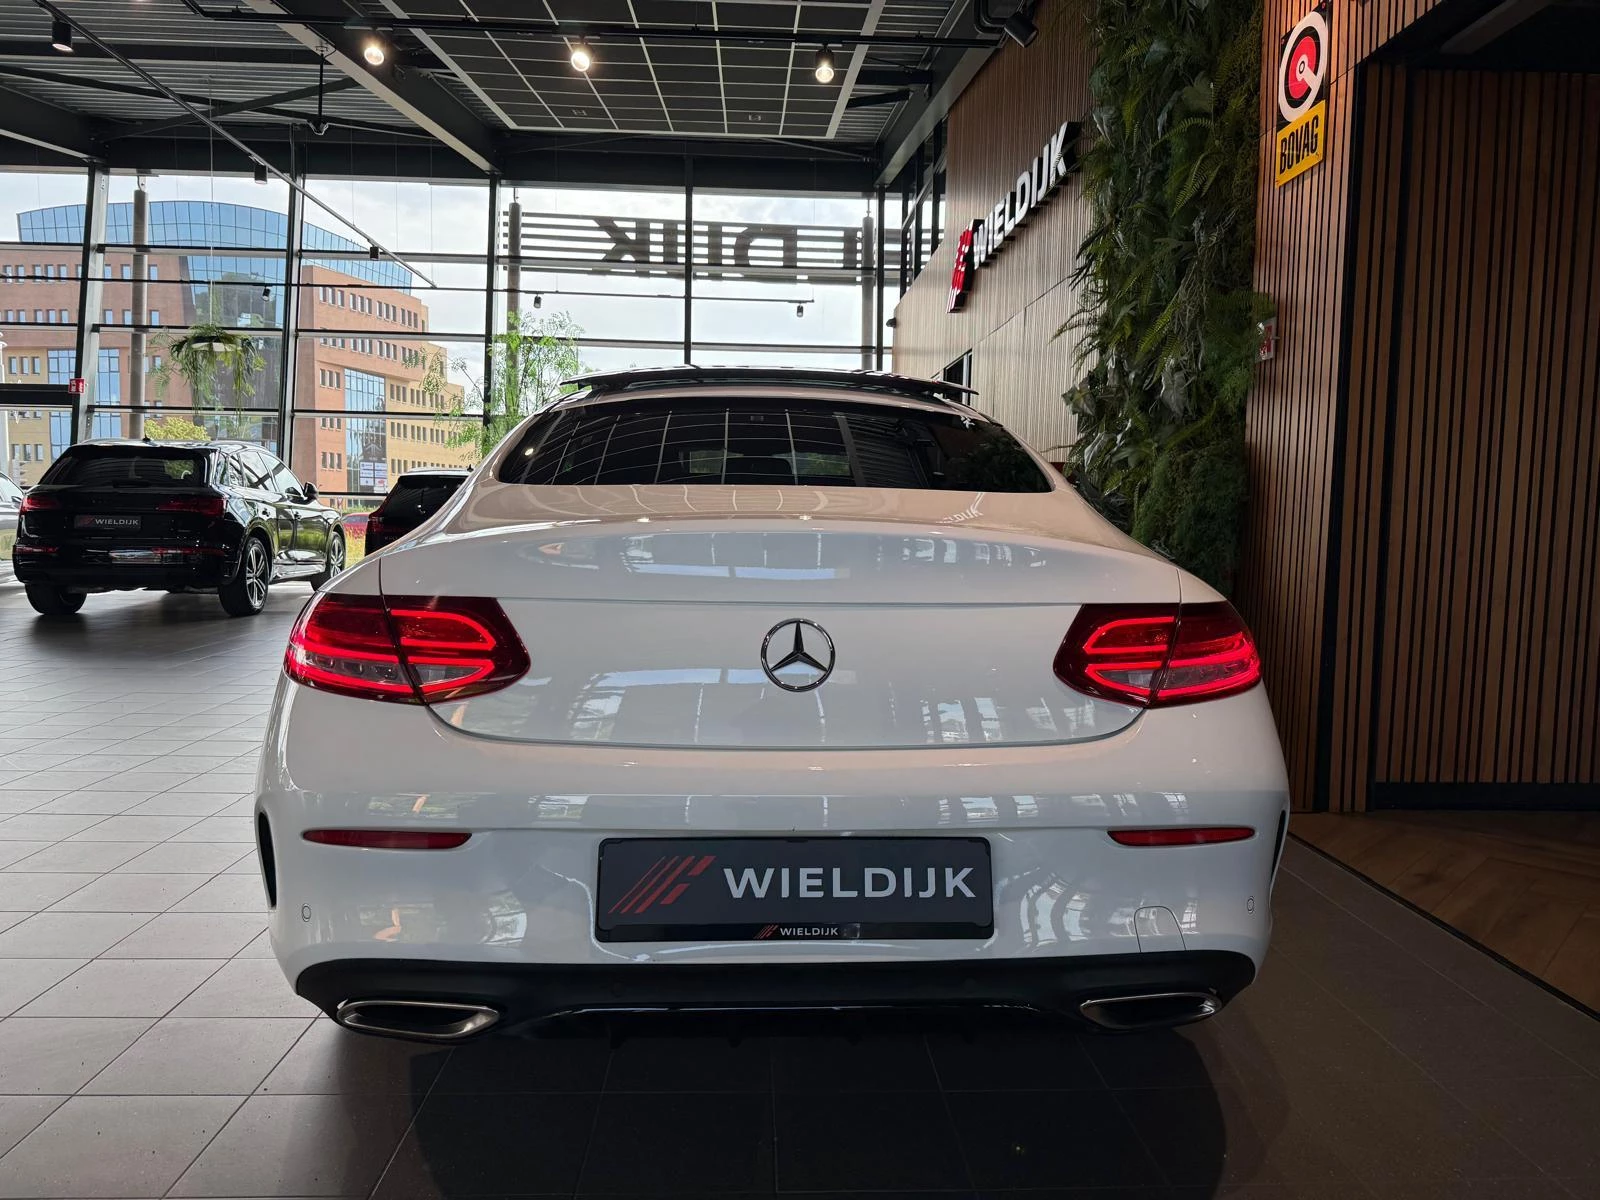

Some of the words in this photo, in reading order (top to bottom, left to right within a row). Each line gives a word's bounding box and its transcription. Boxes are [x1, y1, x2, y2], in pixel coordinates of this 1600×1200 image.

[1279, 114, 1319, 175] BOVAG
[973, 121, 1068, 271] WIELDIJK
[95, 518, 139, 526] WIELDIJK
[723, 866, 977, 899] WIELDIJK
[780, 927, 839, 936] WIELDIJK
